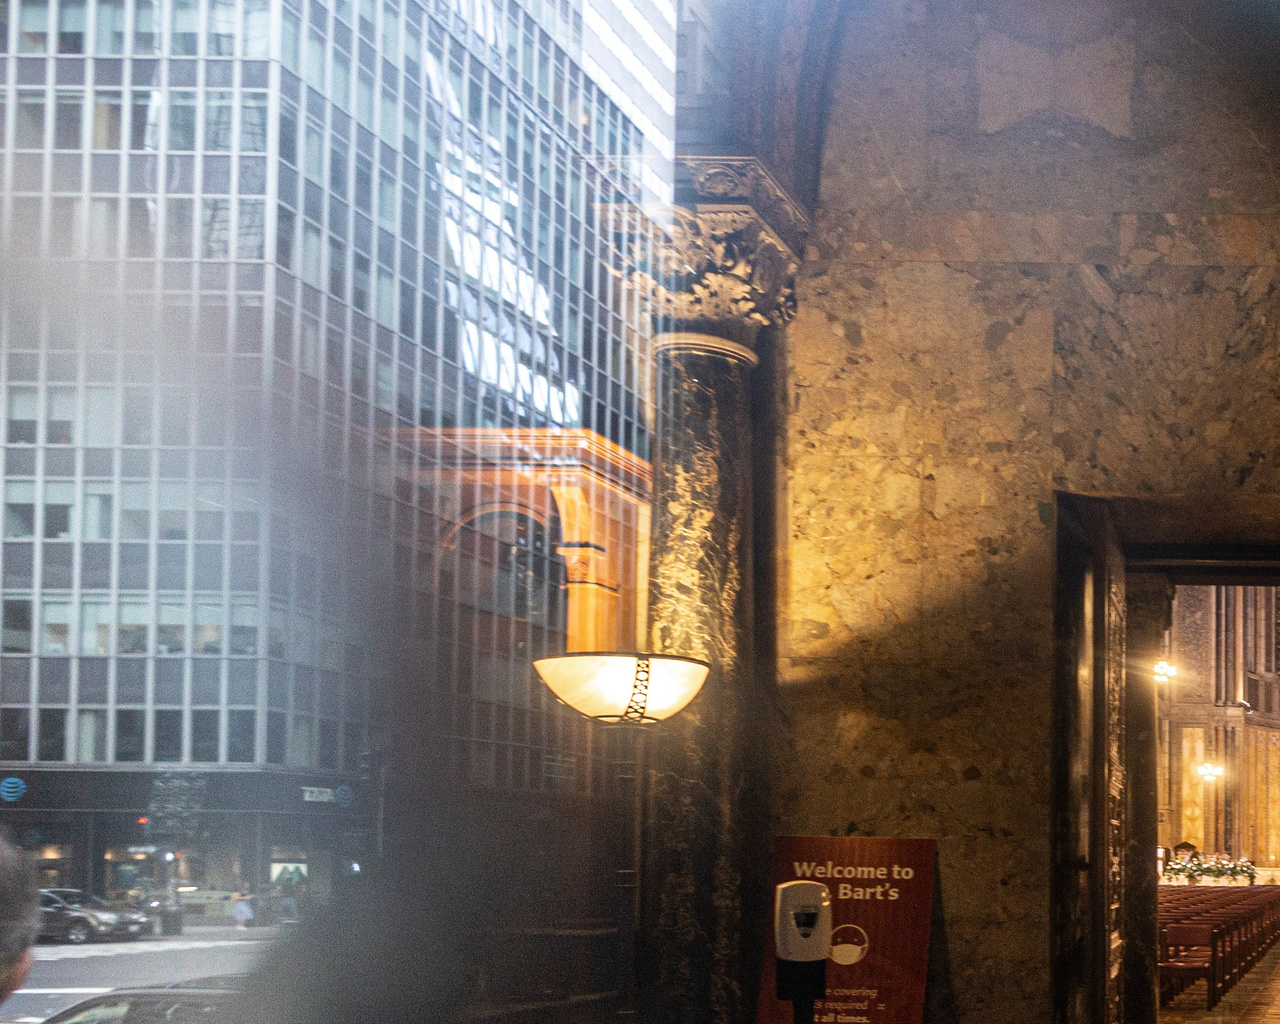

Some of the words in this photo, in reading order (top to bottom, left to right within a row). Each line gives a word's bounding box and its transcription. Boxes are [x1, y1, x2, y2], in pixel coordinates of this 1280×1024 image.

[793, 861, 888, 879] Welcome
[892, 864, 915, 880] to
[838, 883, 900, 900] Bart's
[833, 987, 878, 999] covering
[825, 999, 869, 1011] required
